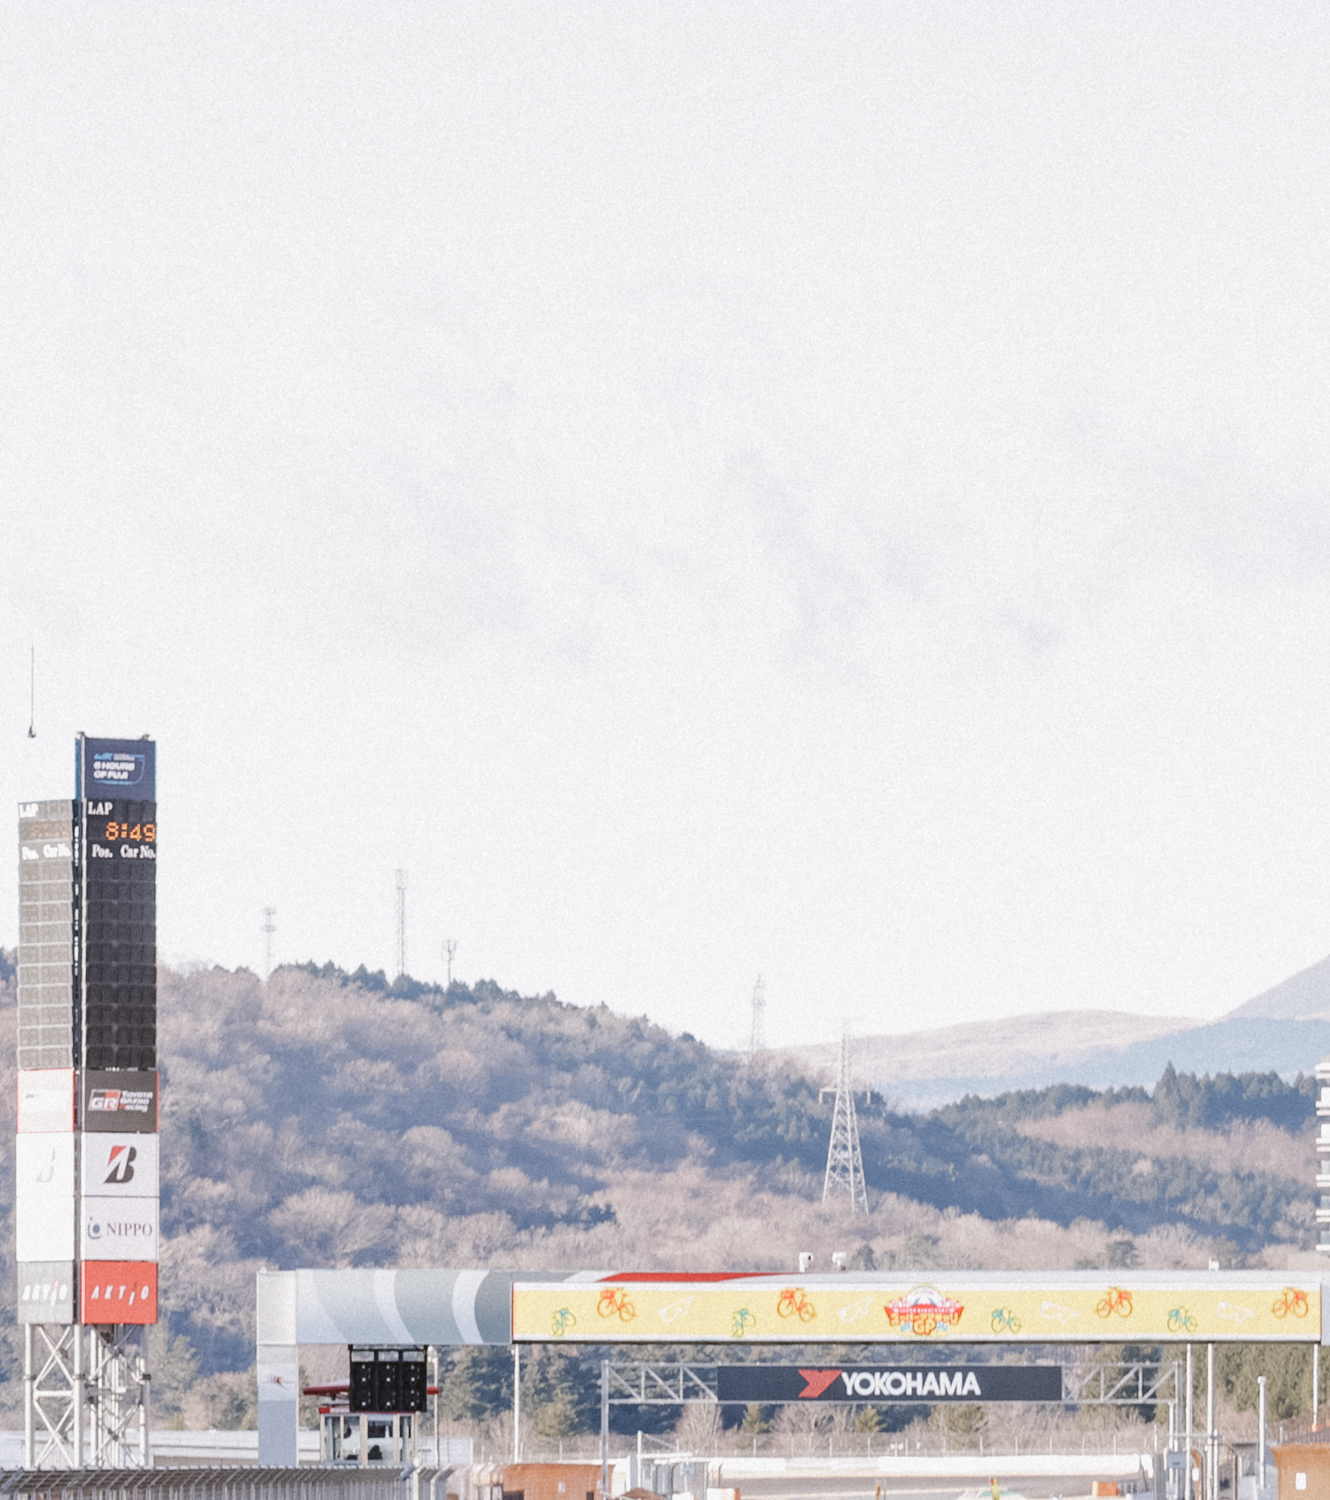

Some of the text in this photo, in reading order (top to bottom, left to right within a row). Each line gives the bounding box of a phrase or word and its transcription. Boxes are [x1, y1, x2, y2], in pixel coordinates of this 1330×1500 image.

[101, 761, 135, 771] HOURS
[19, 803, 39, 818] LAP
[88, 801, 113, 815] LAP
[105, 821, 156, 842] 8:49
[92, 844, 156, 859] Pos. Car No.
[121, 1090, 153, 1099] TOYOTA
[107, 1222, 152, 1237] NIPPO
[841, 1371, 981, 1397] YOKOHAMA
